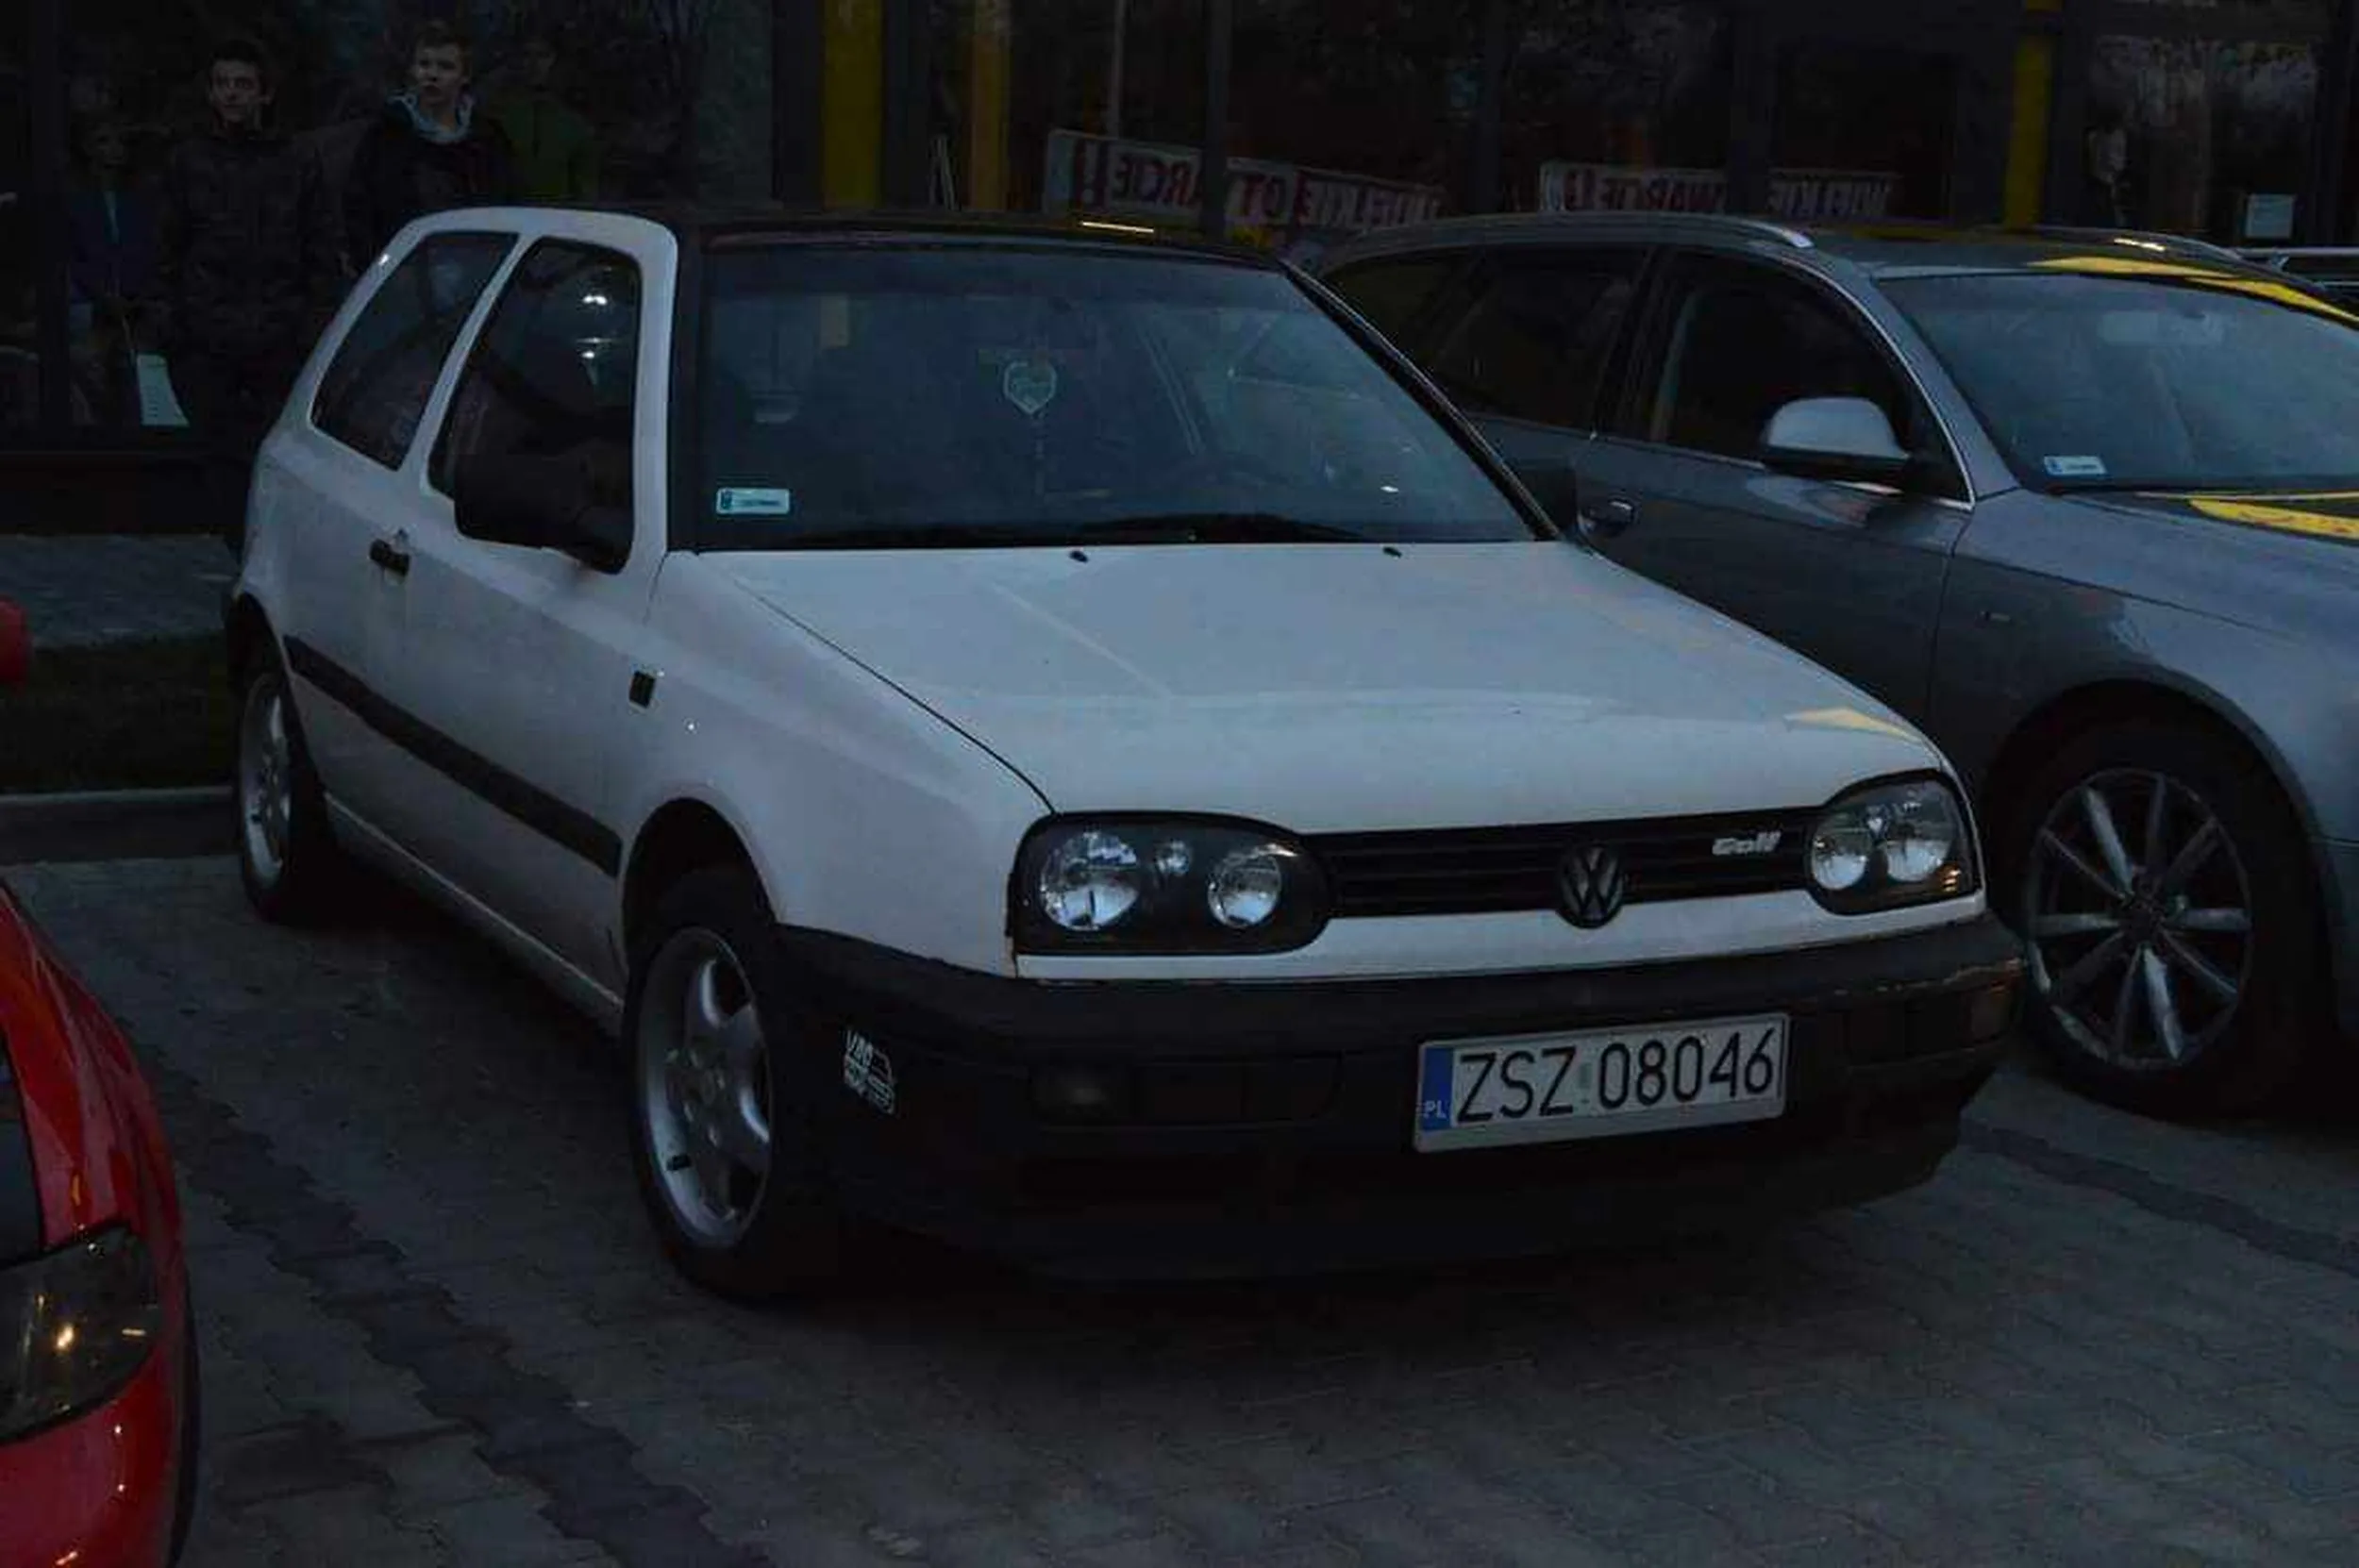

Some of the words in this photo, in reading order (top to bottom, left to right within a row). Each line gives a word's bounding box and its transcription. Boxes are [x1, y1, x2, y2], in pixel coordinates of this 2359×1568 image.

[1458, 1047, 1576, 1123] ZSZ
[1600, 1028, 1775, 1108] 08046
[1425, 1099, 1448, 1120] PL
